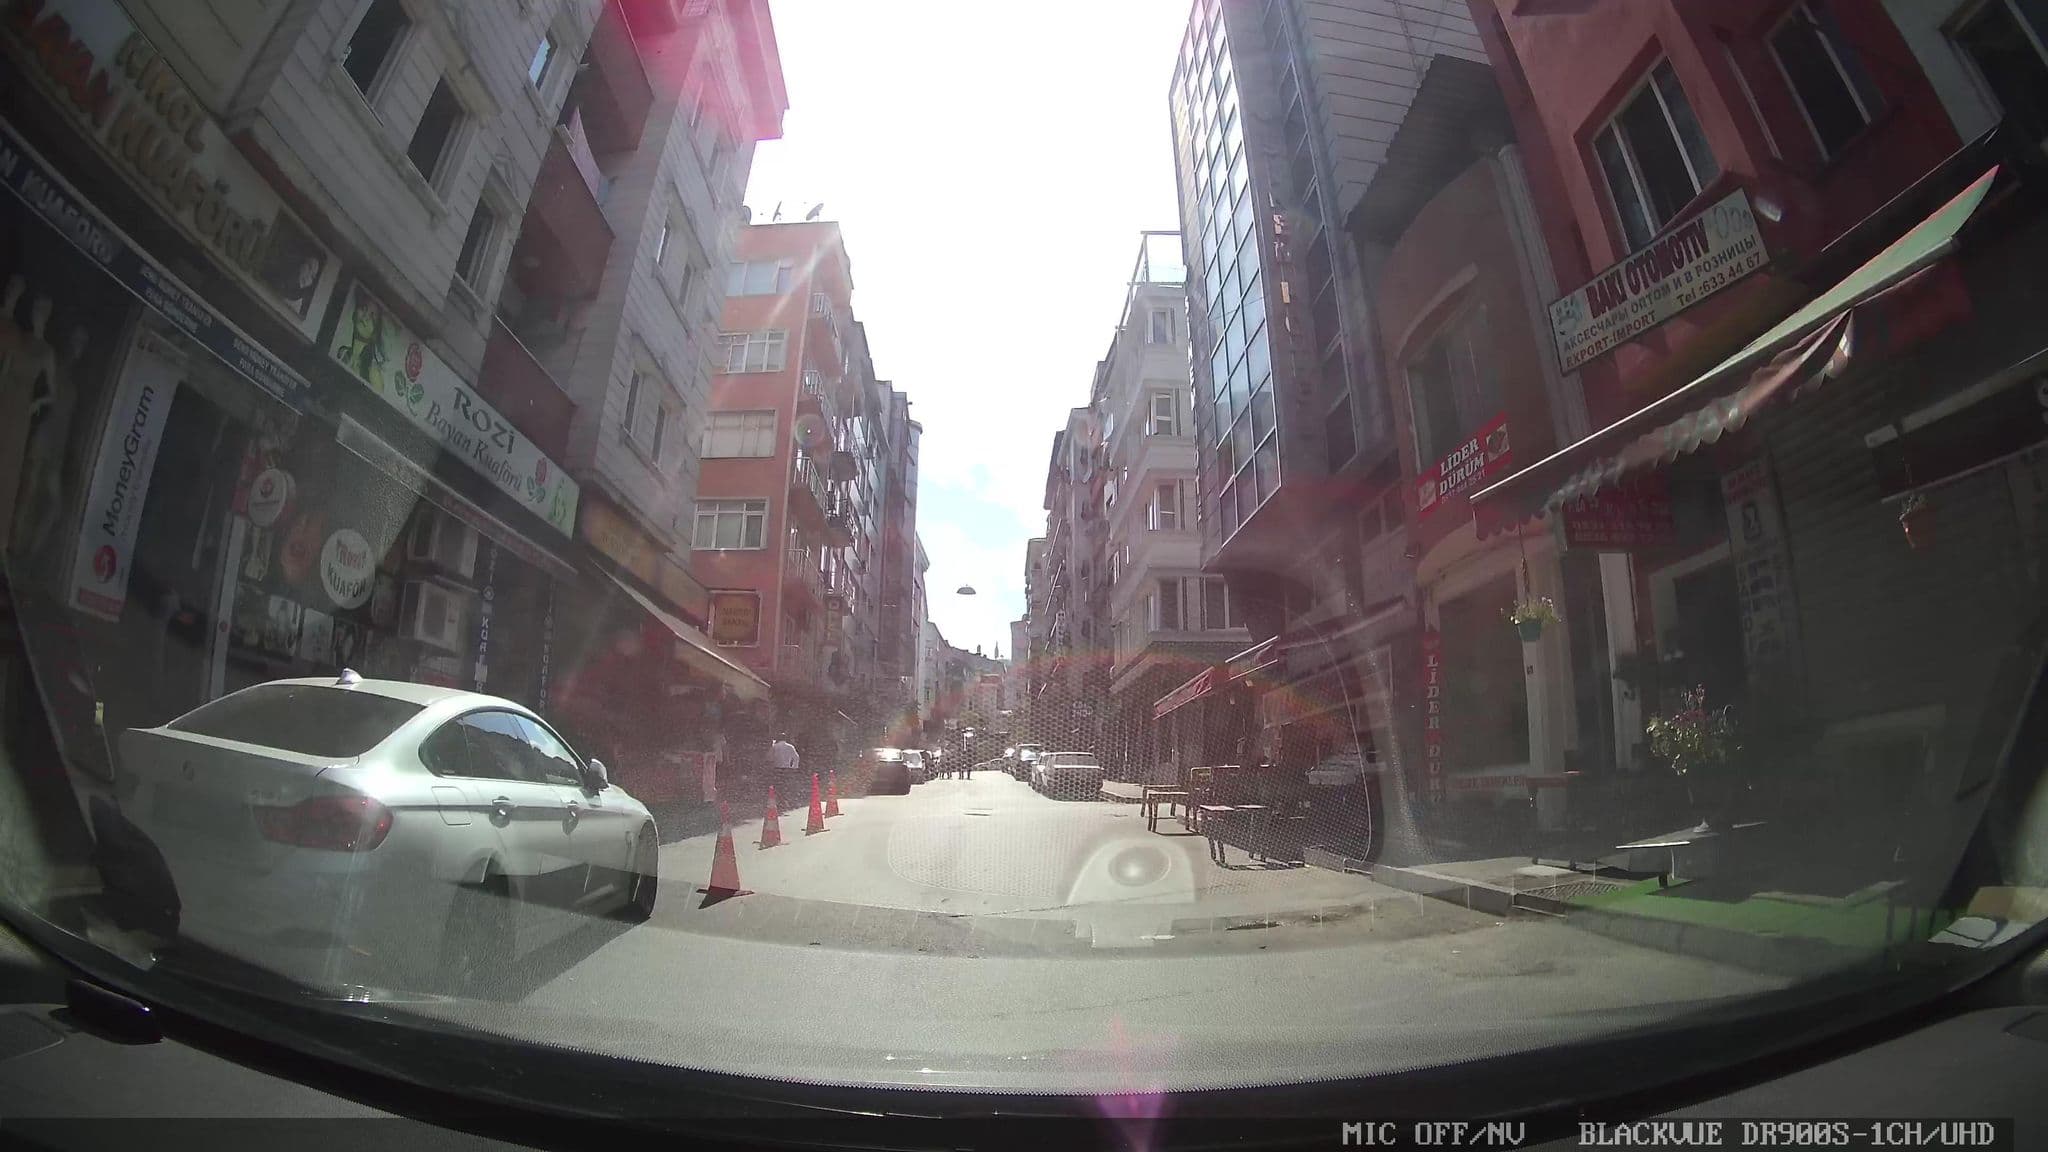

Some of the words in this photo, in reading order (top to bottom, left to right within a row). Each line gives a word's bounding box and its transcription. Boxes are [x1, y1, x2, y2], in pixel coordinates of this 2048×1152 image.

[1566, 311, 1656, 368] EXPORT-IMPORT
[103, 385, 154, 536] MoneyGram
[426, 400, 472, 452] Bayan
[473, 439, 522, 492] Kuaförü
[1439, 451, 1485, 496] DÜRÜM
[1440, 438, 1480, 477] LİDER
